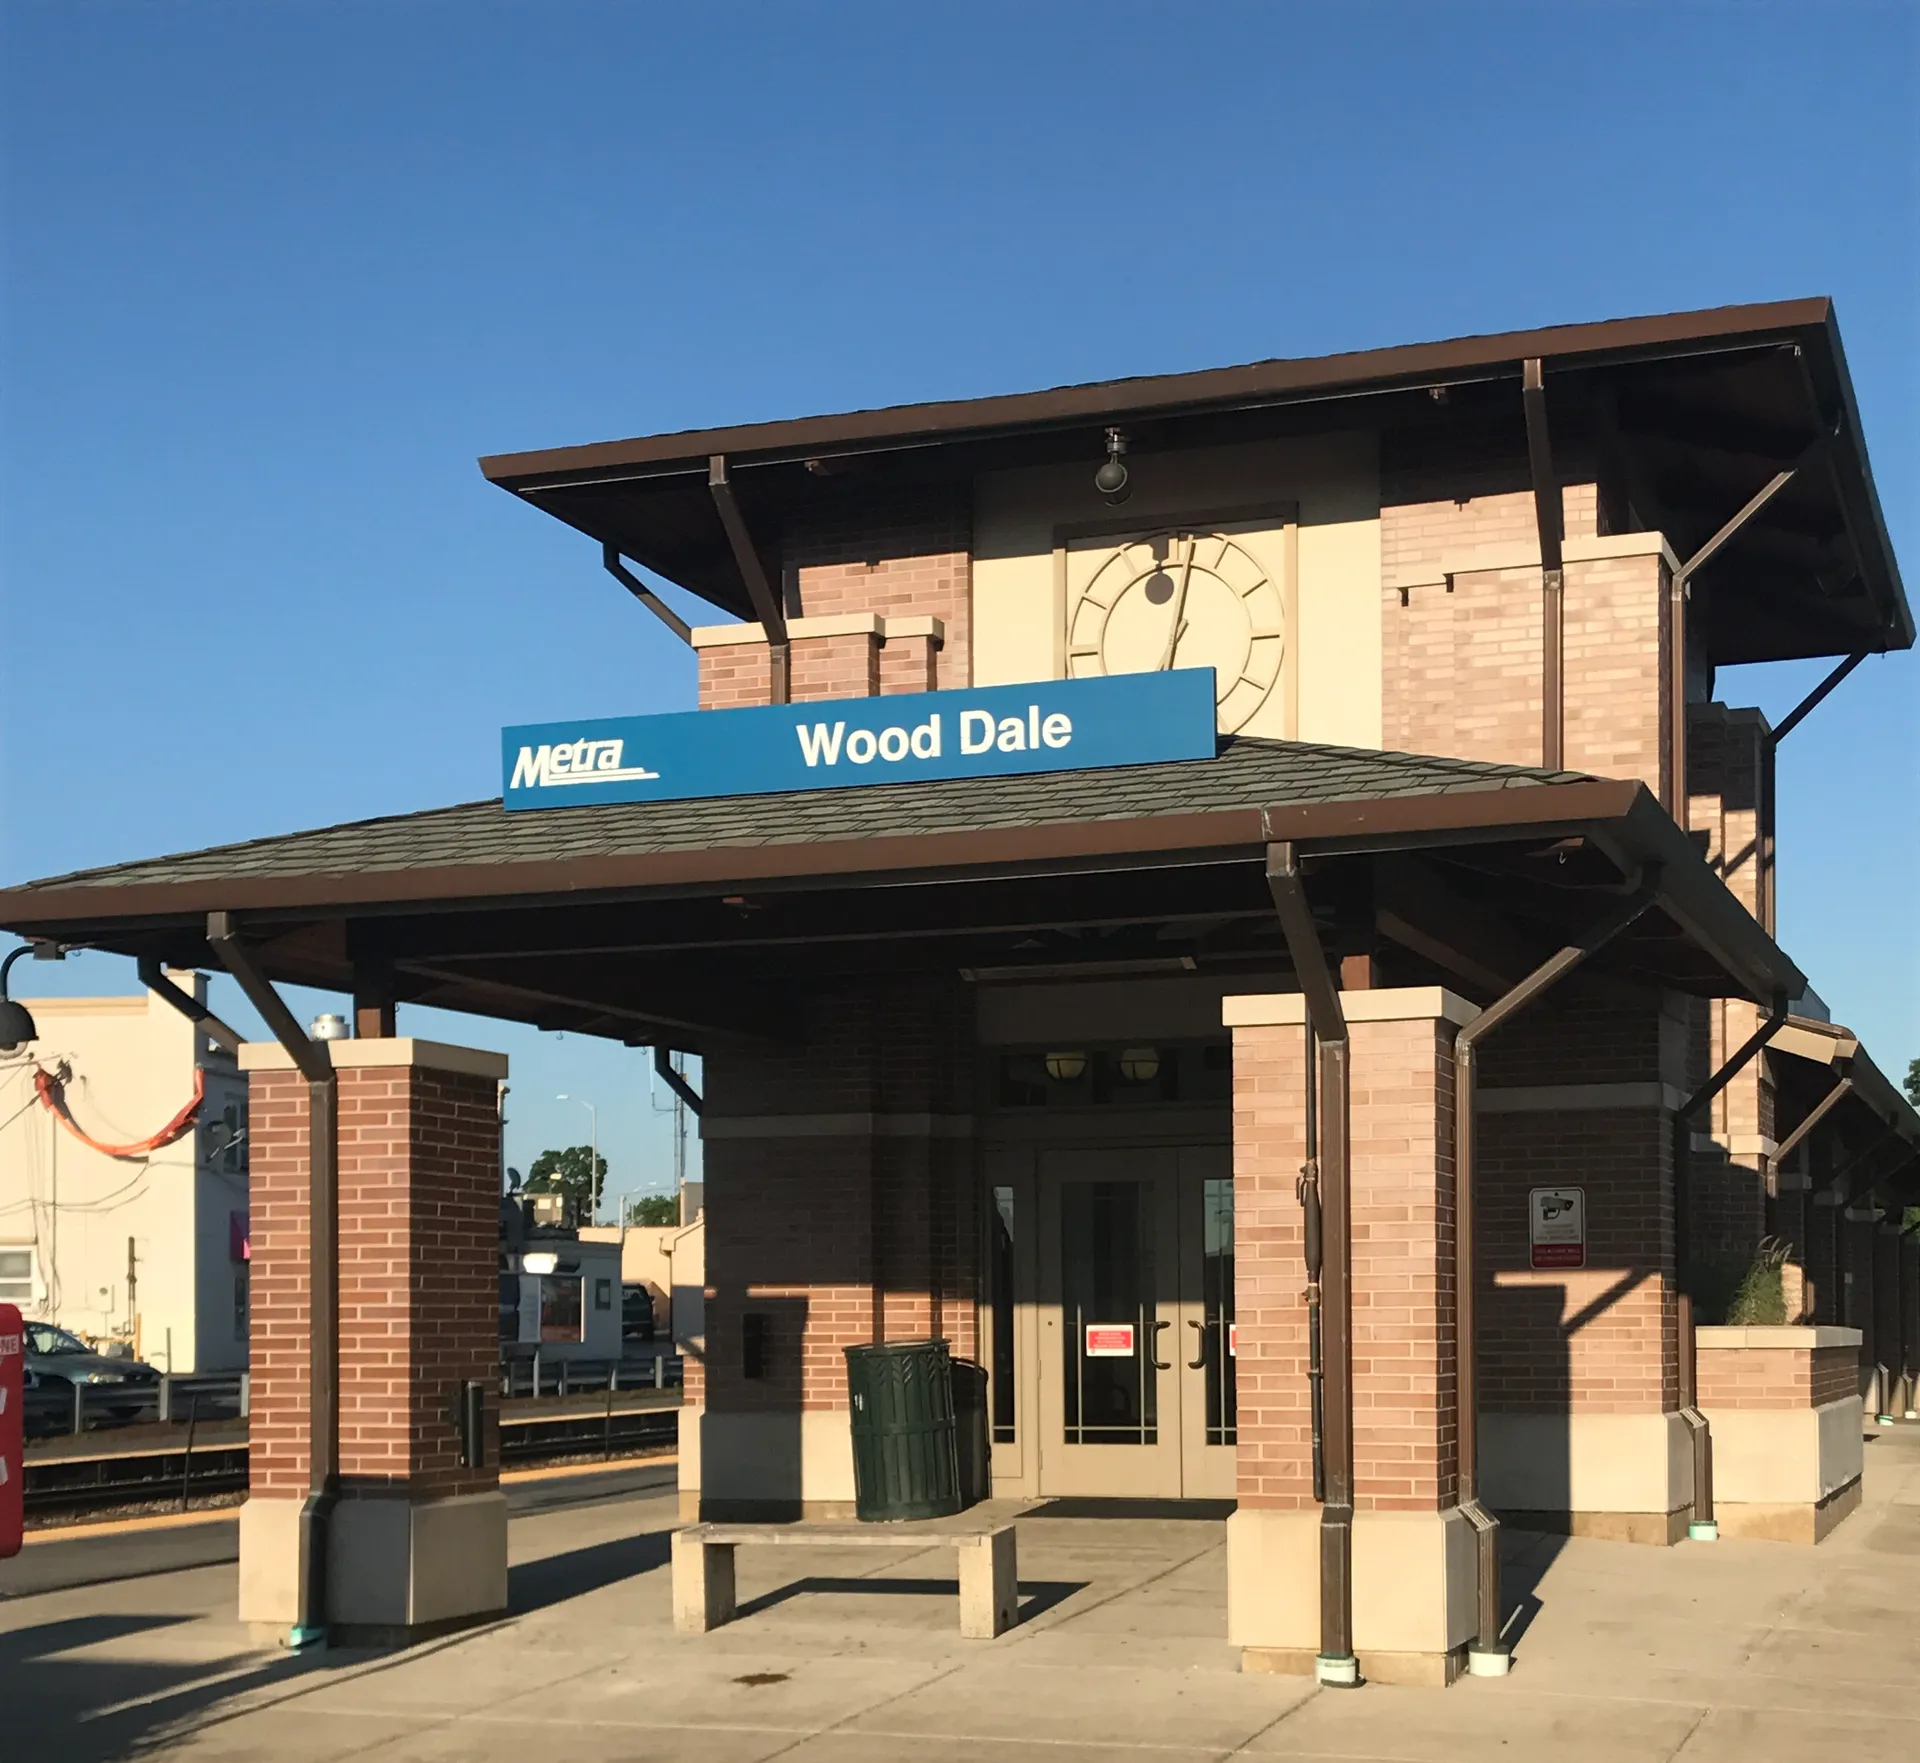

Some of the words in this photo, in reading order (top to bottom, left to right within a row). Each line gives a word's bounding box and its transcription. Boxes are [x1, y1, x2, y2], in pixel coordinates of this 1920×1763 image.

[509, 737, 625, 789] Metra
[796, 714, 943, 768] Wood
[959, 704, 1073, 755] Dale
